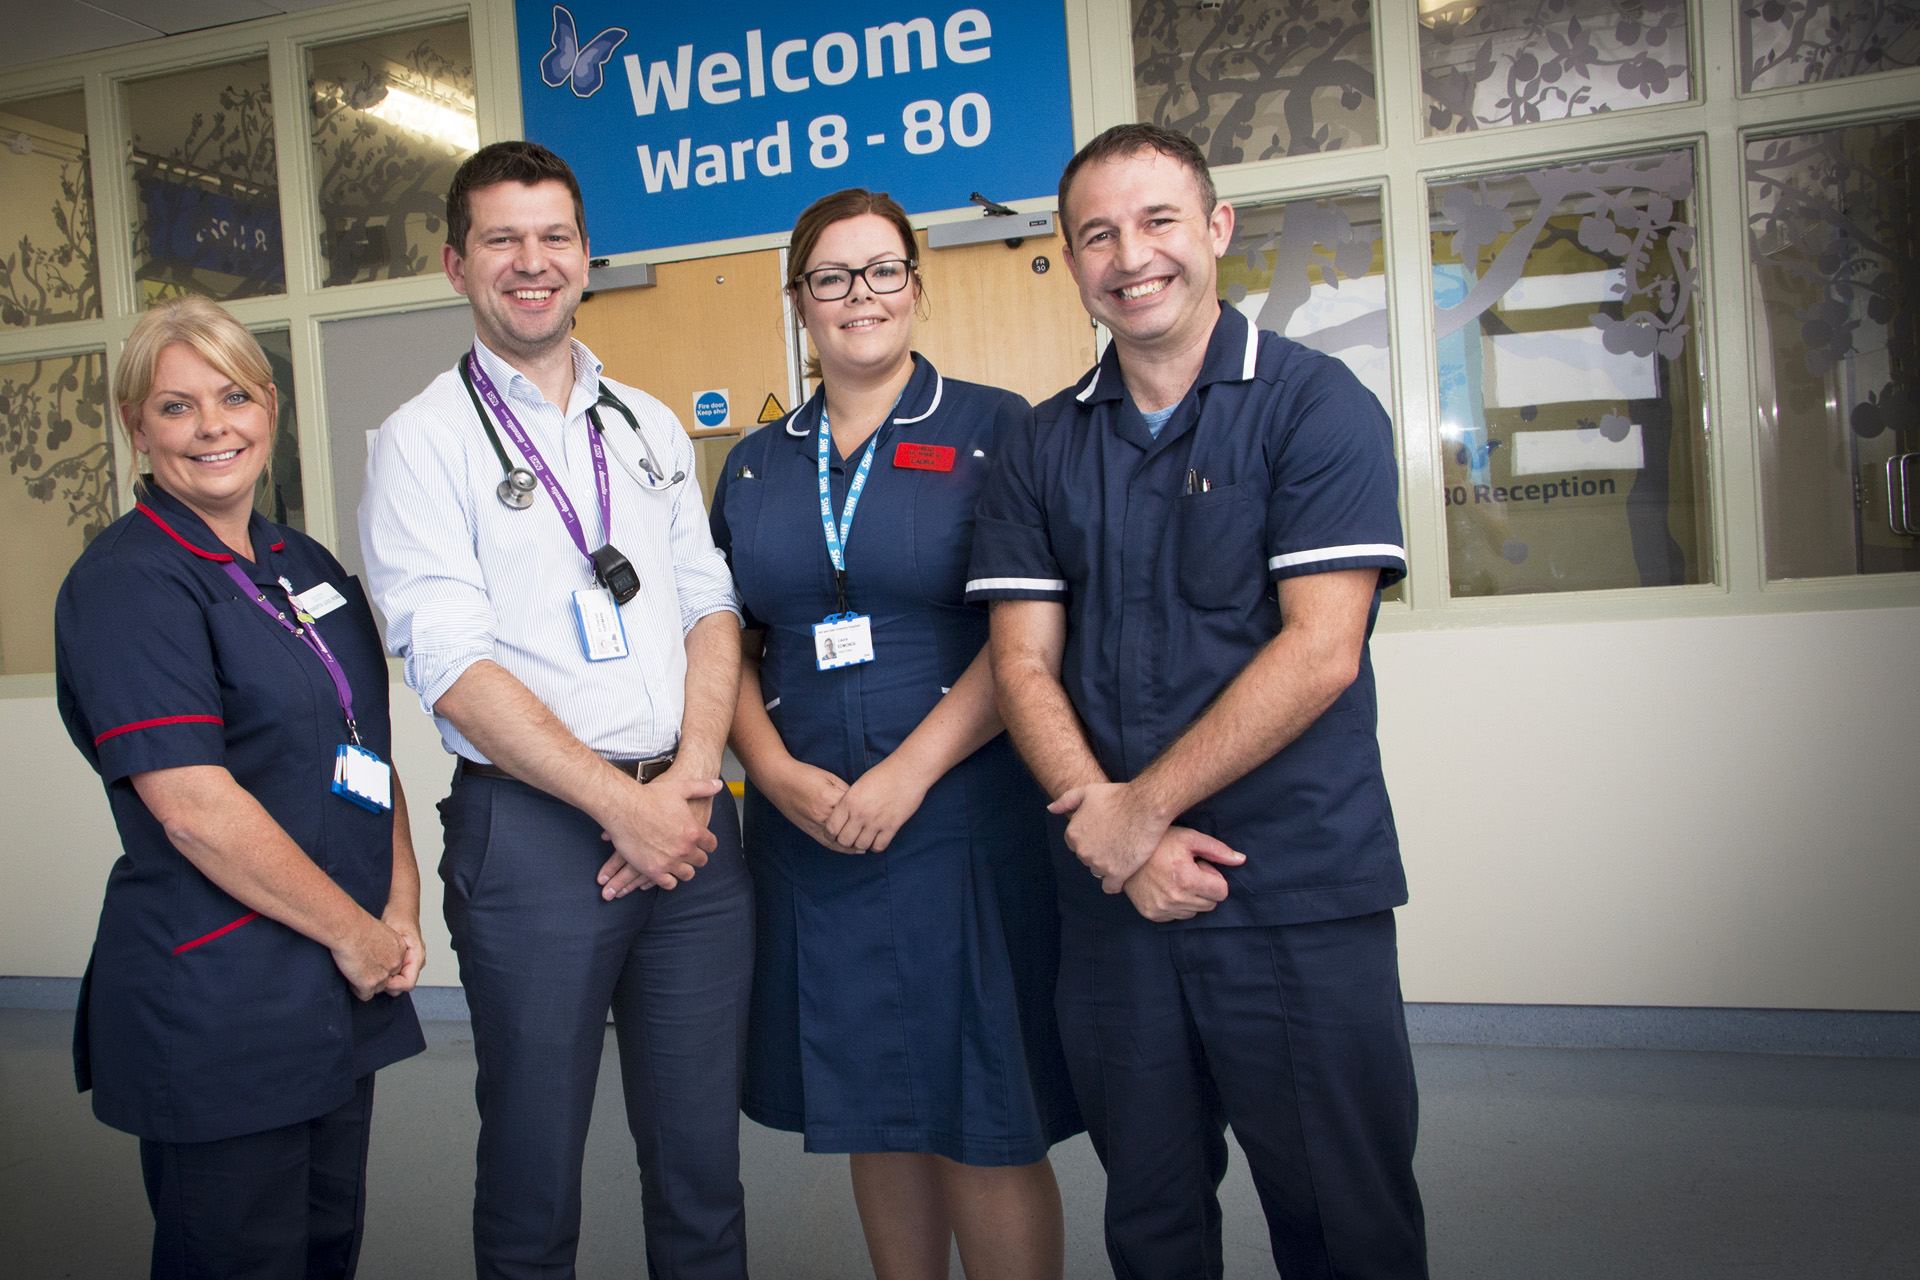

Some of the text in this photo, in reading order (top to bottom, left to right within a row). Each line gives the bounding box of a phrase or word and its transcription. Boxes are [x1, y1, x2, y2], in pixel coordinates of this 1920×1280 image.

[623, 8, 992, 117] Welcome
[636, 120, 792, 194] Ward
[808, 114, 849, 169] 8
[902, 92, 992, 155] 80
[820, 420, 829, 435] NHS
[819, 438, 829, 453] NHS
[819, 456, 828, 473] NHS
[861, 450, 873, 470] NHS
[819, 476, 828, 494] NHS
[852, 472, 866, 492] NHS
[1473, 476, 1616, 504] Reception
[820, 497, 831, 516] NHS
[843, 496, 857, 517] NHS
[824, 521, 837, 543] NHS
